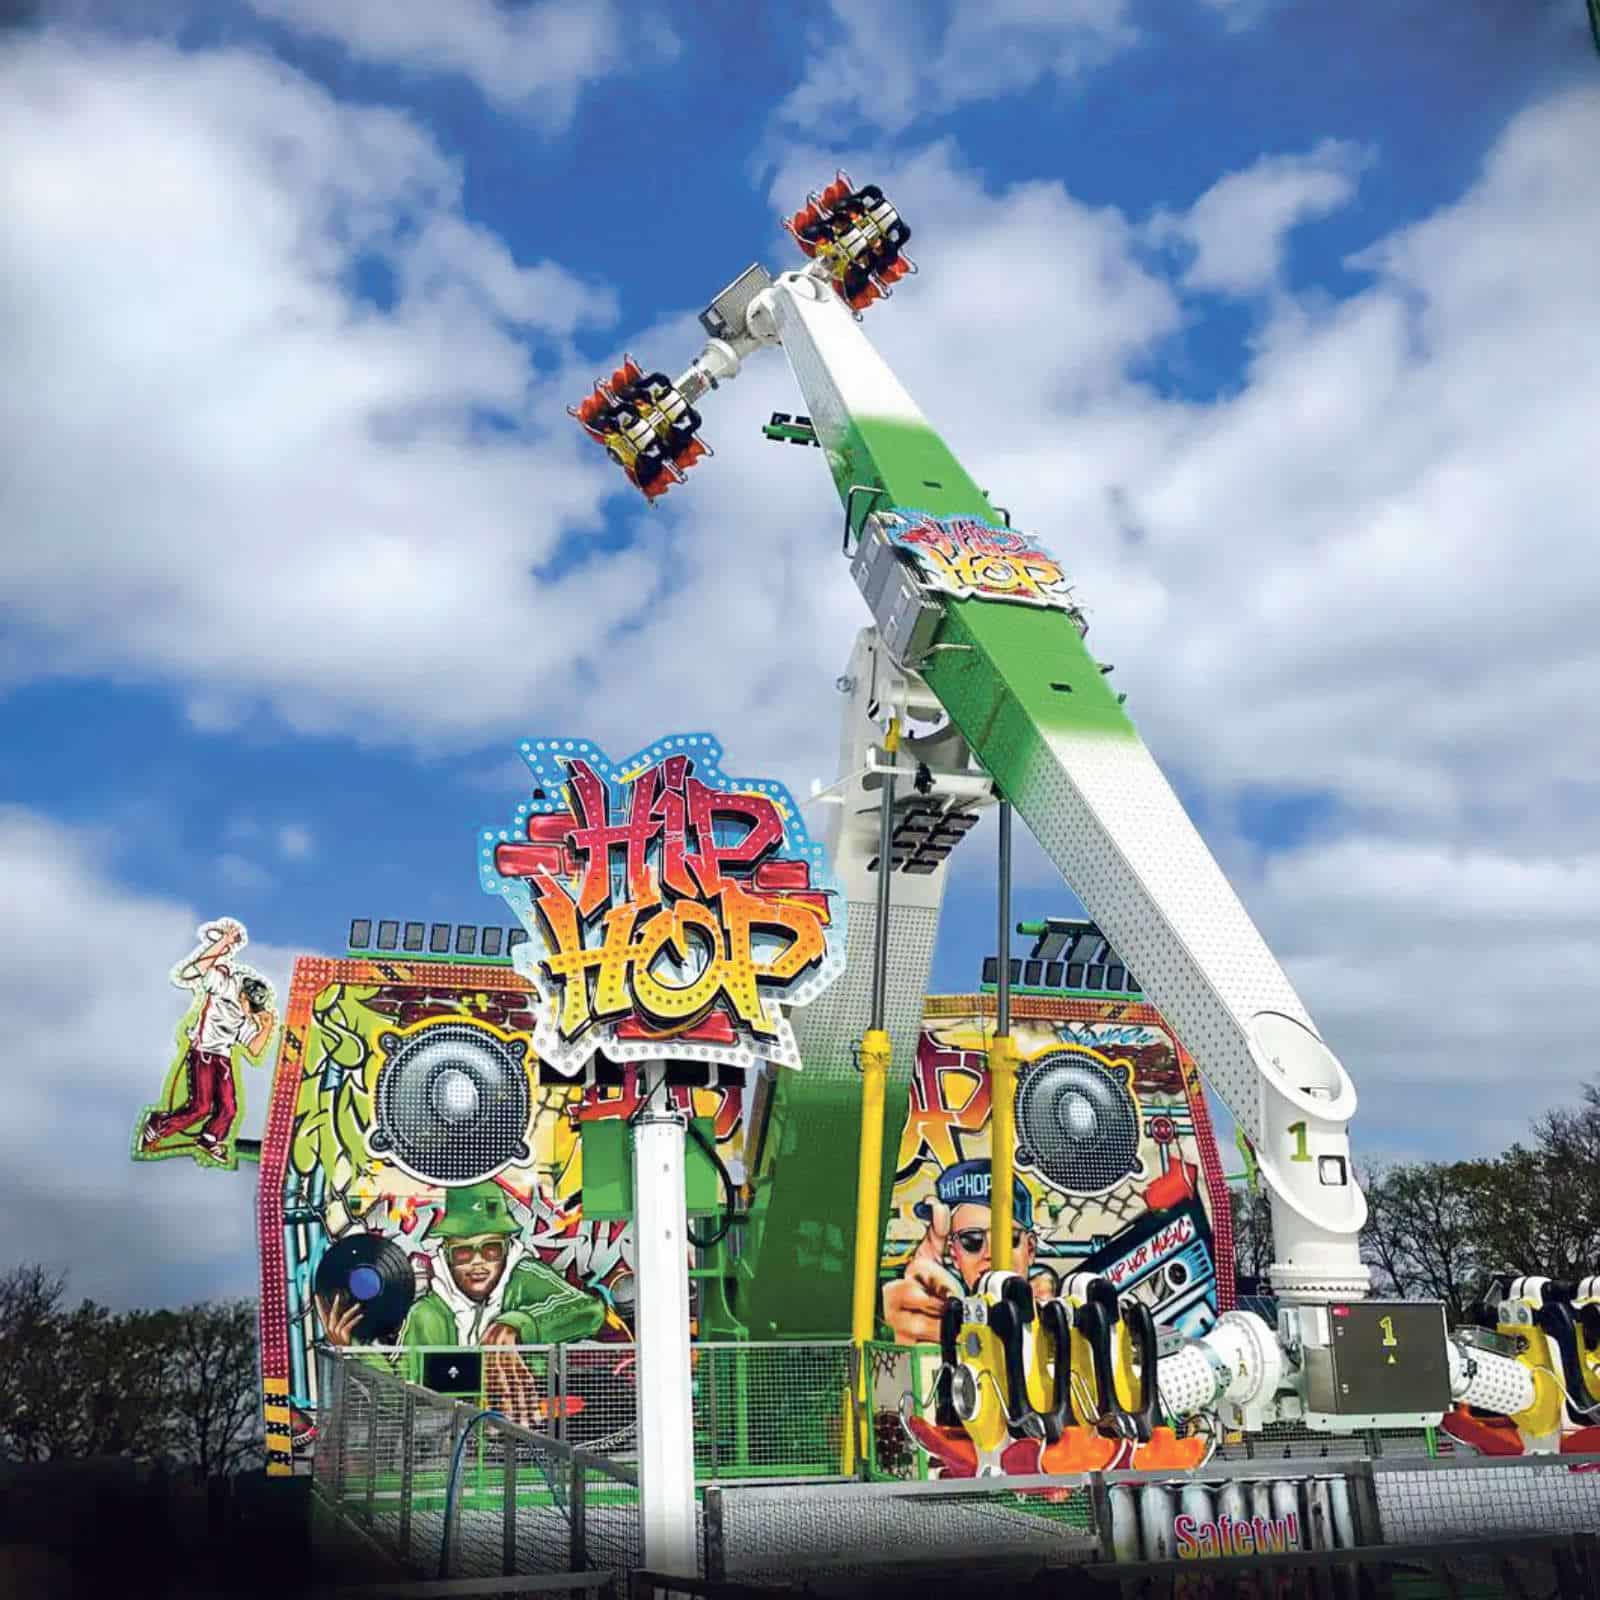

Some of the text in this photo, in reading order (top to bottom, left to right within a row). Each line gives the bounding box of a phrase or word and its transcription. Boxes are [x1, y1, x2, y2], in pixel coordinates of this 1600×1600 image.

[927, 547, 1064, 598] HOP
[543, 873, 828, 1042] HOP
[1287, 1120, 1313, 1162] 1
[1380, 1316, 1397, 1346] 1
[1174, 1513, 1298, 1559] Safety!
